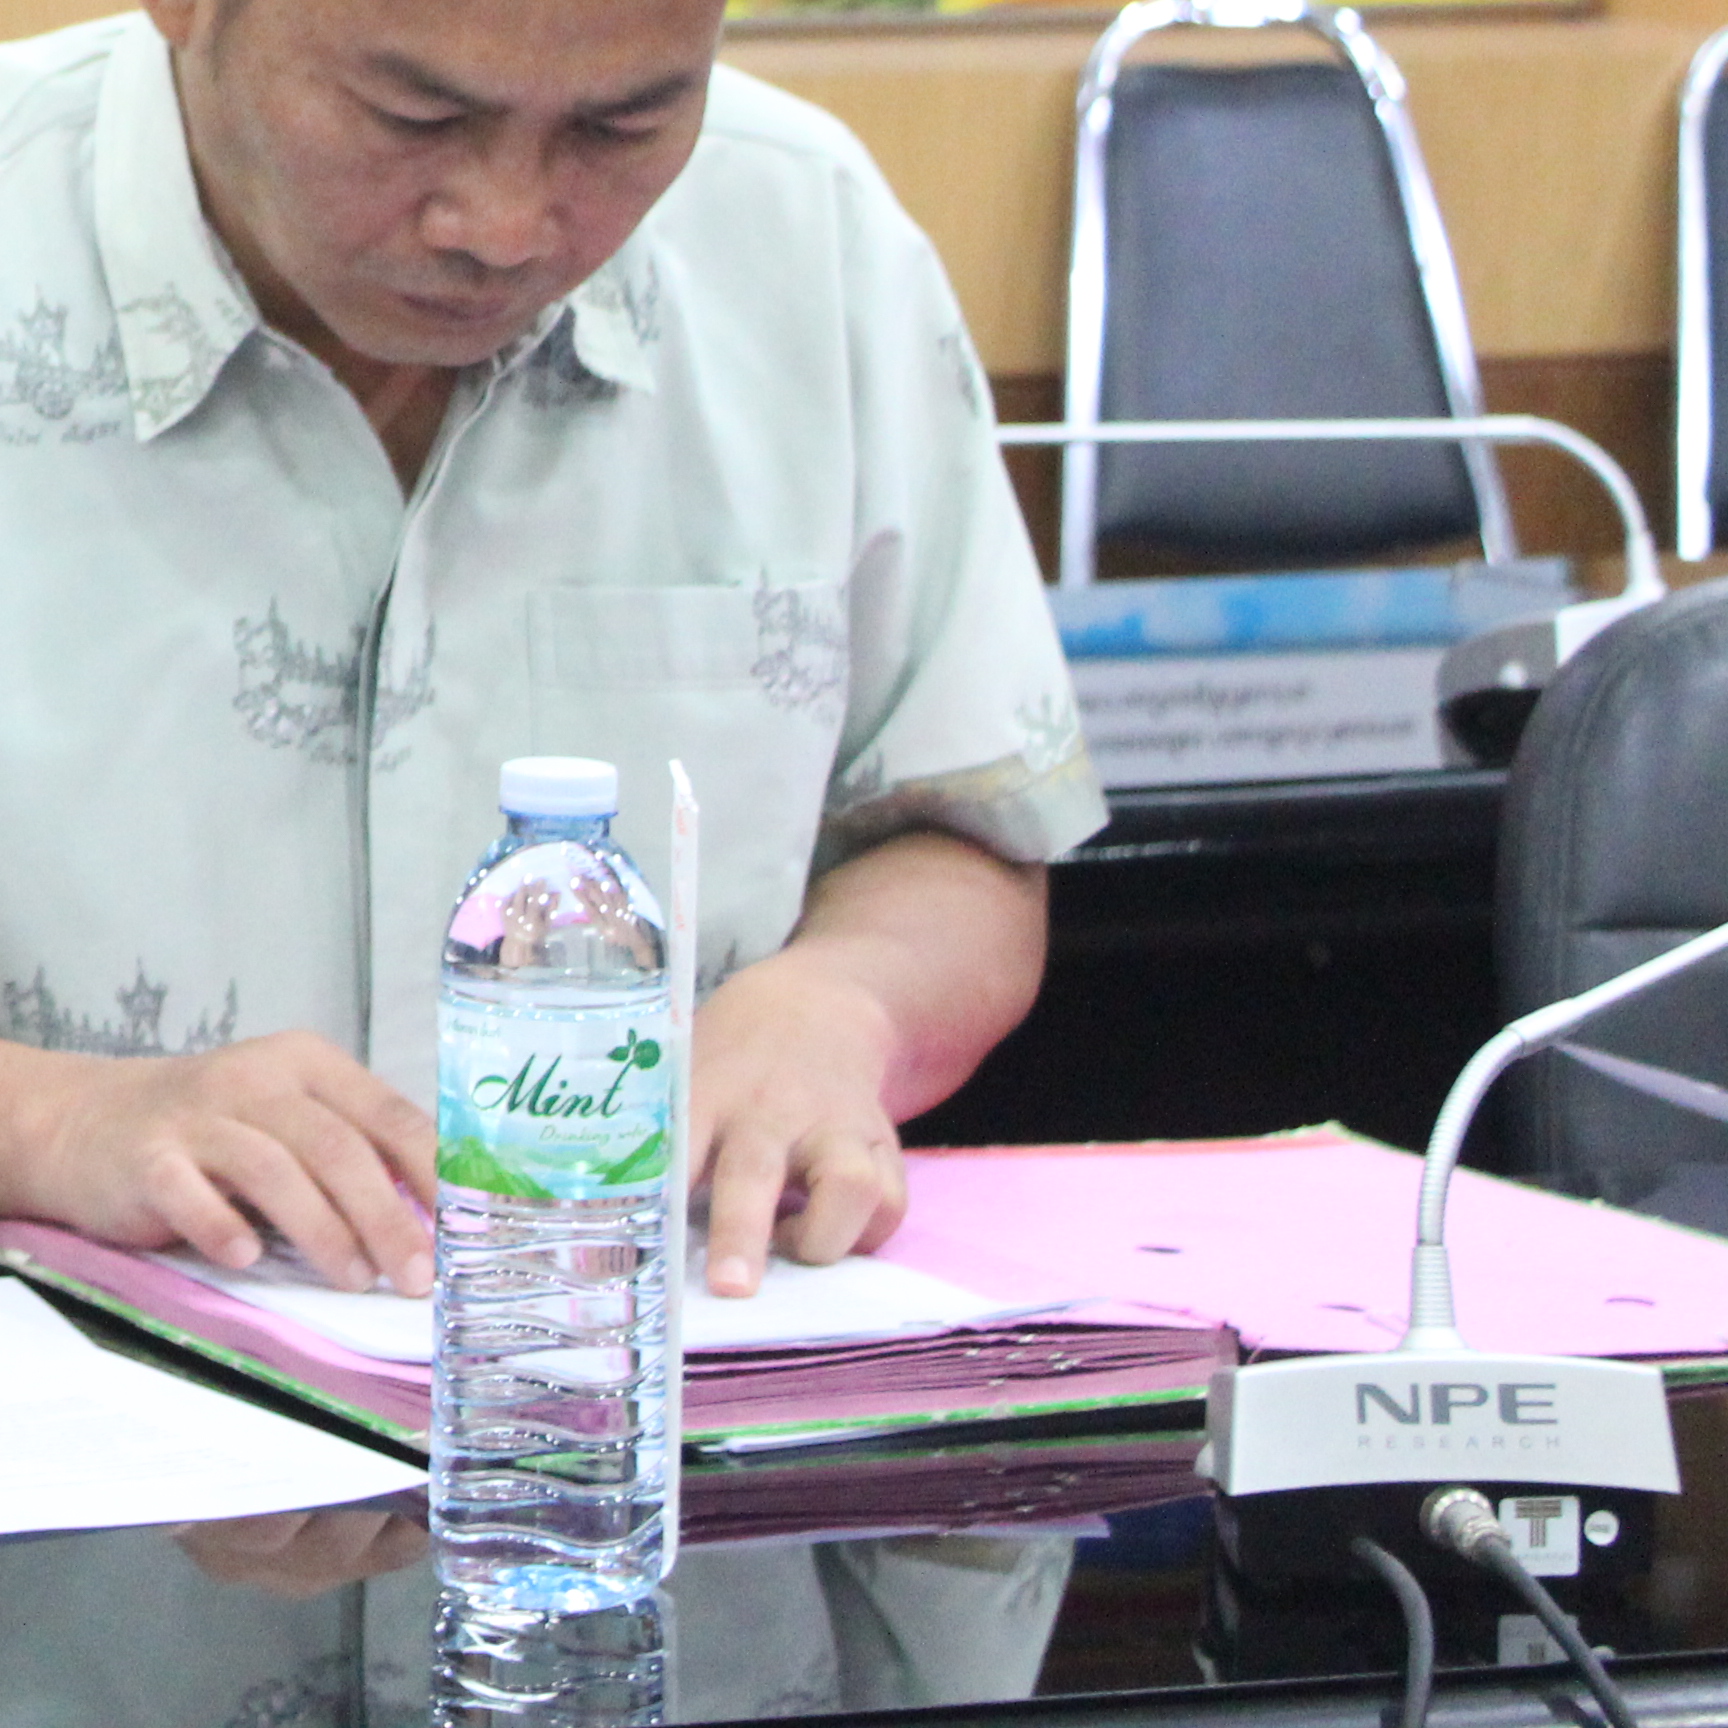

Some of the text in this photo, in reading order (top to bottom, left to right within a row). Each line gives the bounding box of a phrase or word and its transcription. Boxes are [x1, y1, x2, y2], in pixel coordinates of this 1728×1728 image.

[472, 1053, 632, 1118] Mint
[1356, 1382, 1557, 1425] NPE
[1358, 1434, 1561, 1450] RESEARCH
